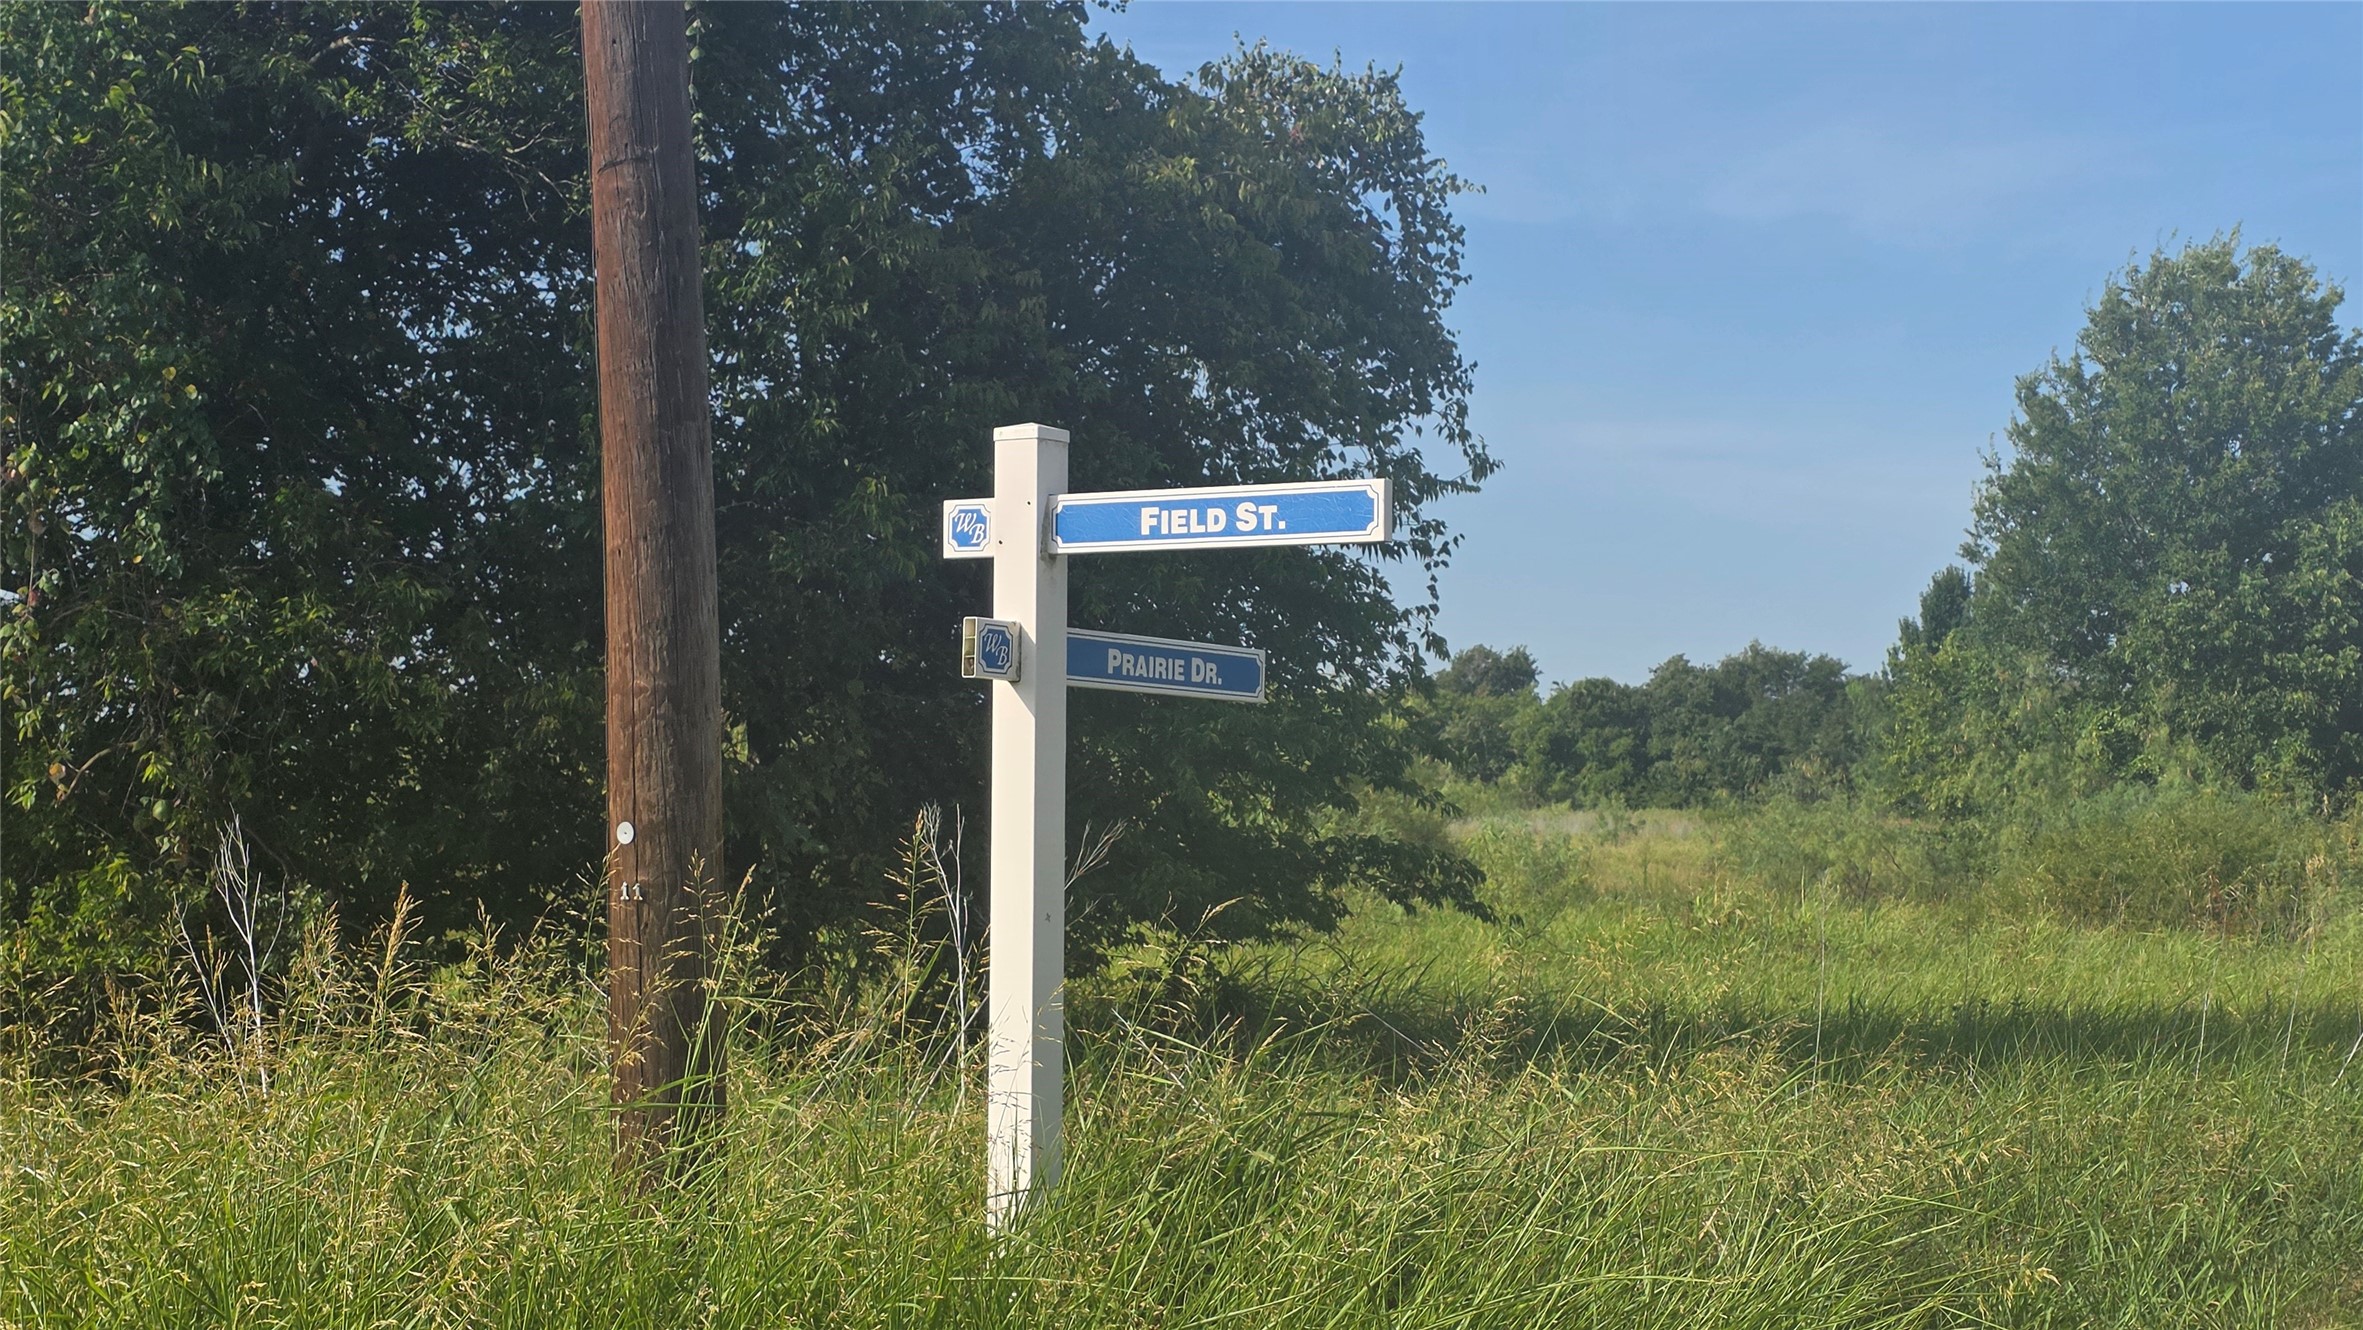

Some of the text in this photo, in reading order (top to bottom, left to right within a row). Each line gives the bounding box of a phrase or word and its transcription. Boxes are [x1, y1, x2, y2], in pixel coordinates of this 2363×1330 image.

[1140, 501, 1286, 535] FIELD ST.
[1107, 648, 1222, 685] PRAIRIE DR.
[620, 881, 643, 901] 11
